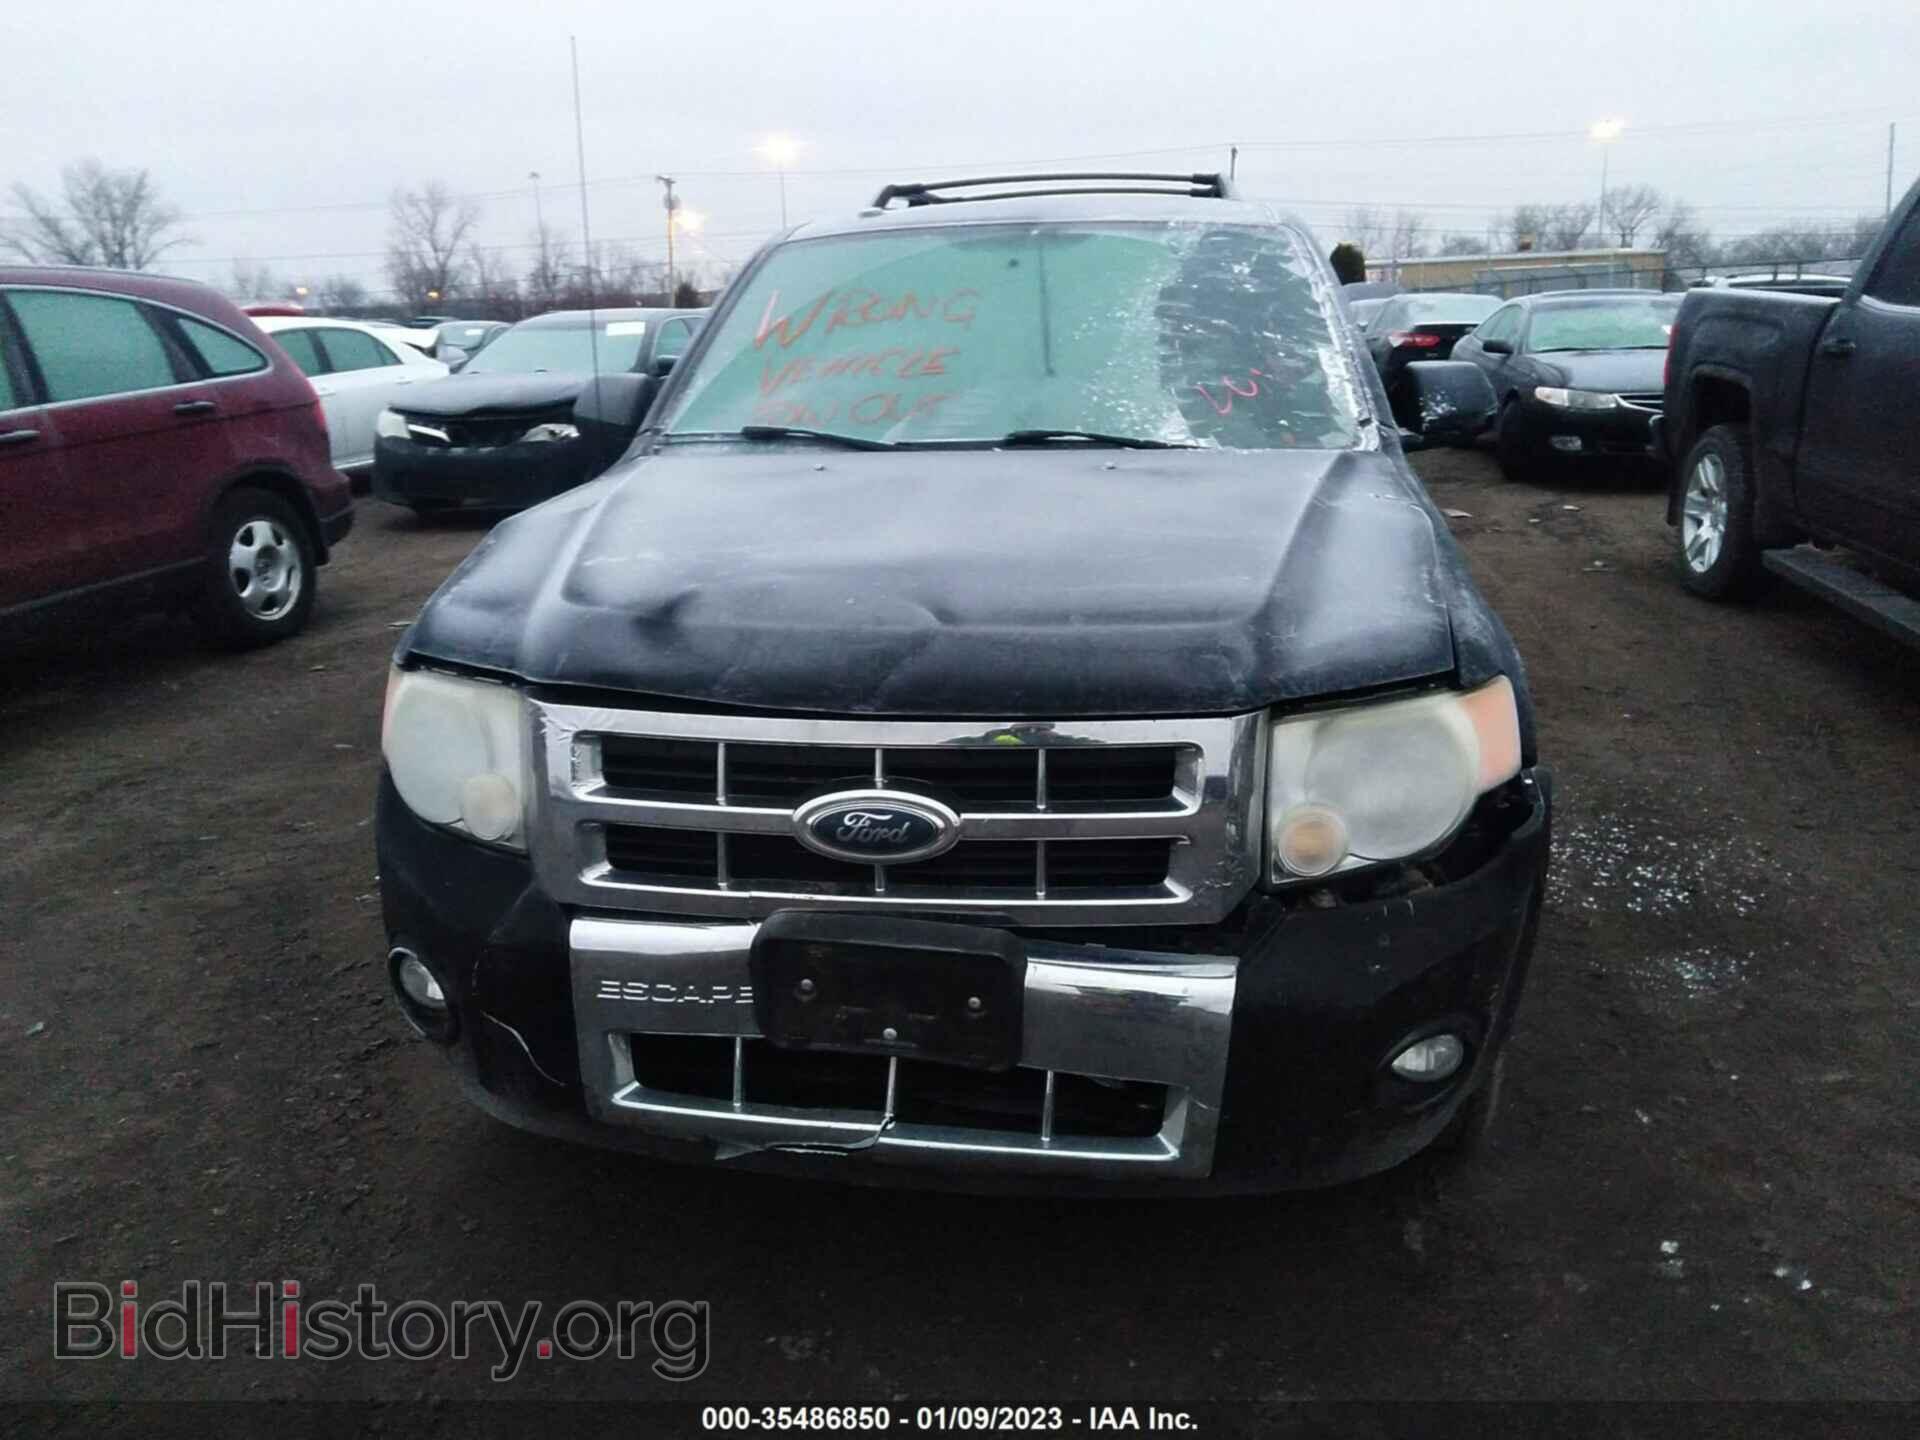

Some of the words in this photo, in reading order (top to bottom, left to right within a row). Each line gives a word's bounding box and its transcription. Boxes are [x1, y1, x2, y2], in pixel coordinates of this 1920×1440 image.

[753, 287, 979, 349] WRONG
[835, 811, 911, 842] Ford
[596, 979, 754, 1004] ESCAPE
